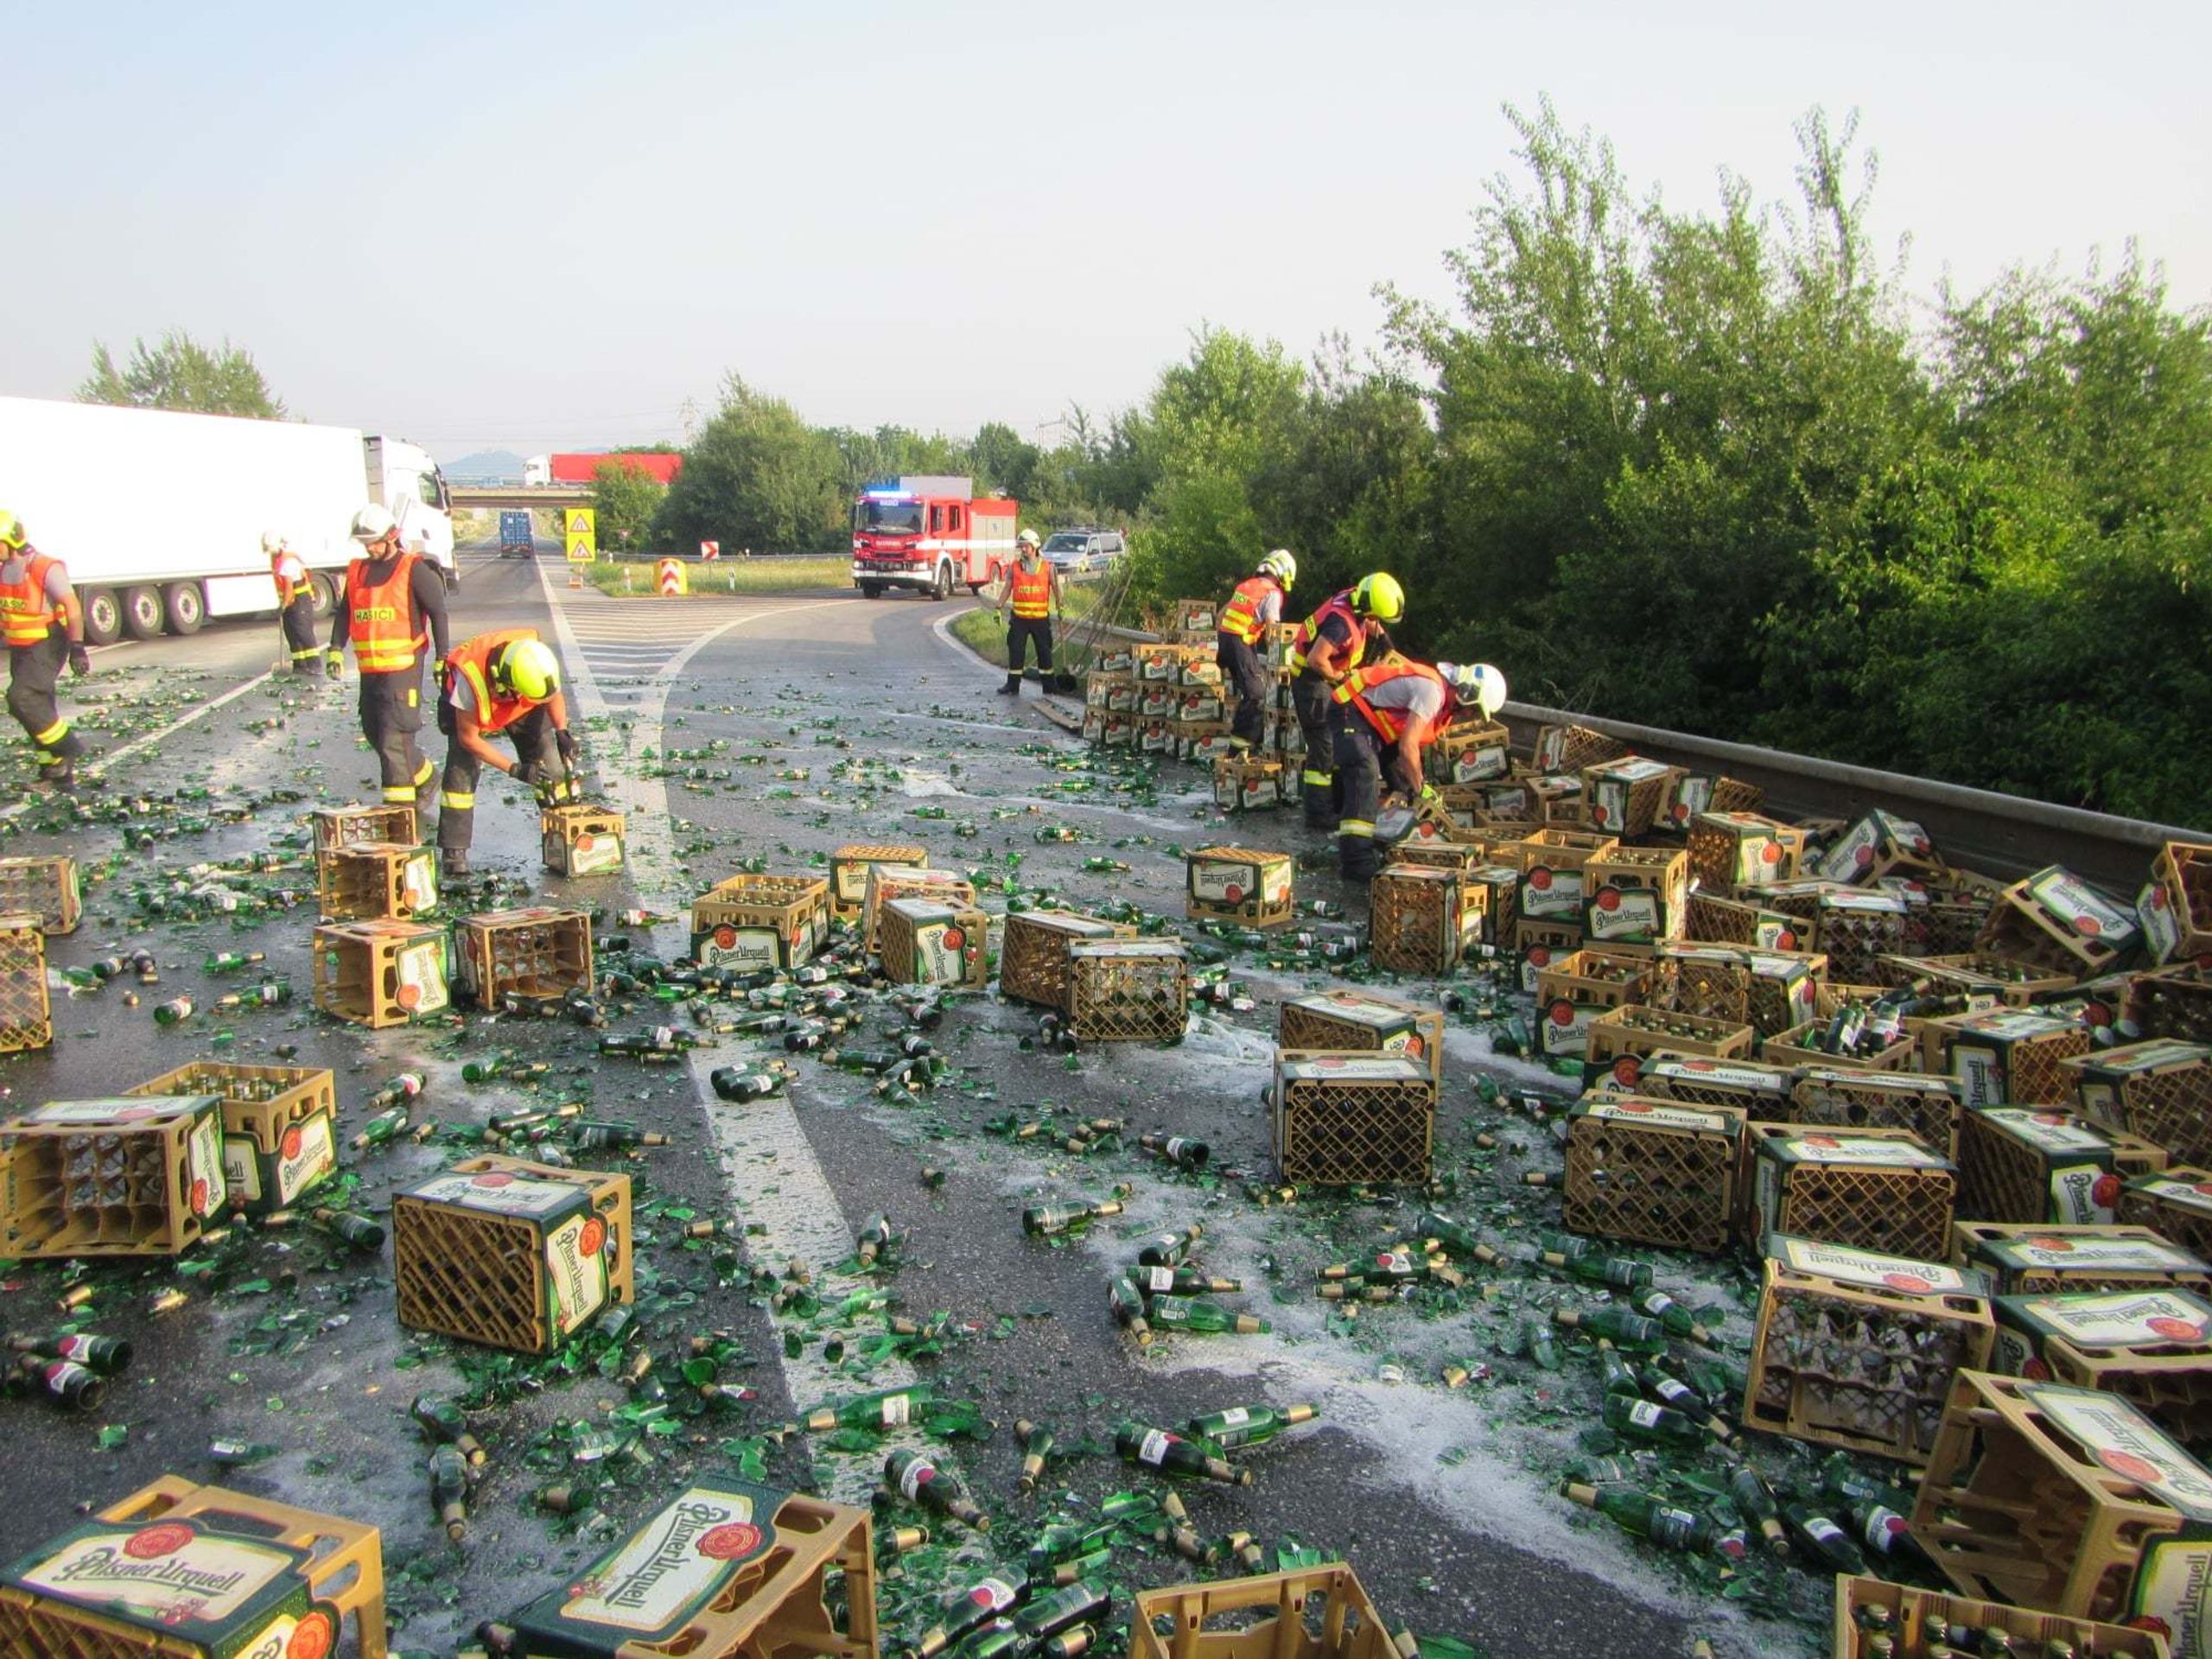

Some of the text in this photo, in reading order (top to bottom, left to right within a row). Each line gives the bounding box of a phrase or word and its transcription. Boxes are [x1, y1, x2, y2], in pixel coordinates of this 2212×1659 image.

[1528, 890, 1555, 906] Pilsner
[1596, 909, 1651, 929] Pilsner Urquell
[709, 944, 771, 967] Pilsner Urquell
[924, 929, 949, 980] Pilsner Urquell
[2063, 1173, 2091, 1215] Pilsner
[556, 1227, 589, 1313] Pilsner Urquell
[1808, 1253, 1942, 1282] Pilsner Urquell
[52, 1547, 245, 1592] Pilsner Urquell
[613, 1503, 731, 1609] Pilsner Urquell
[2172, 1554, 2210, 1659] ilsner Urquell
